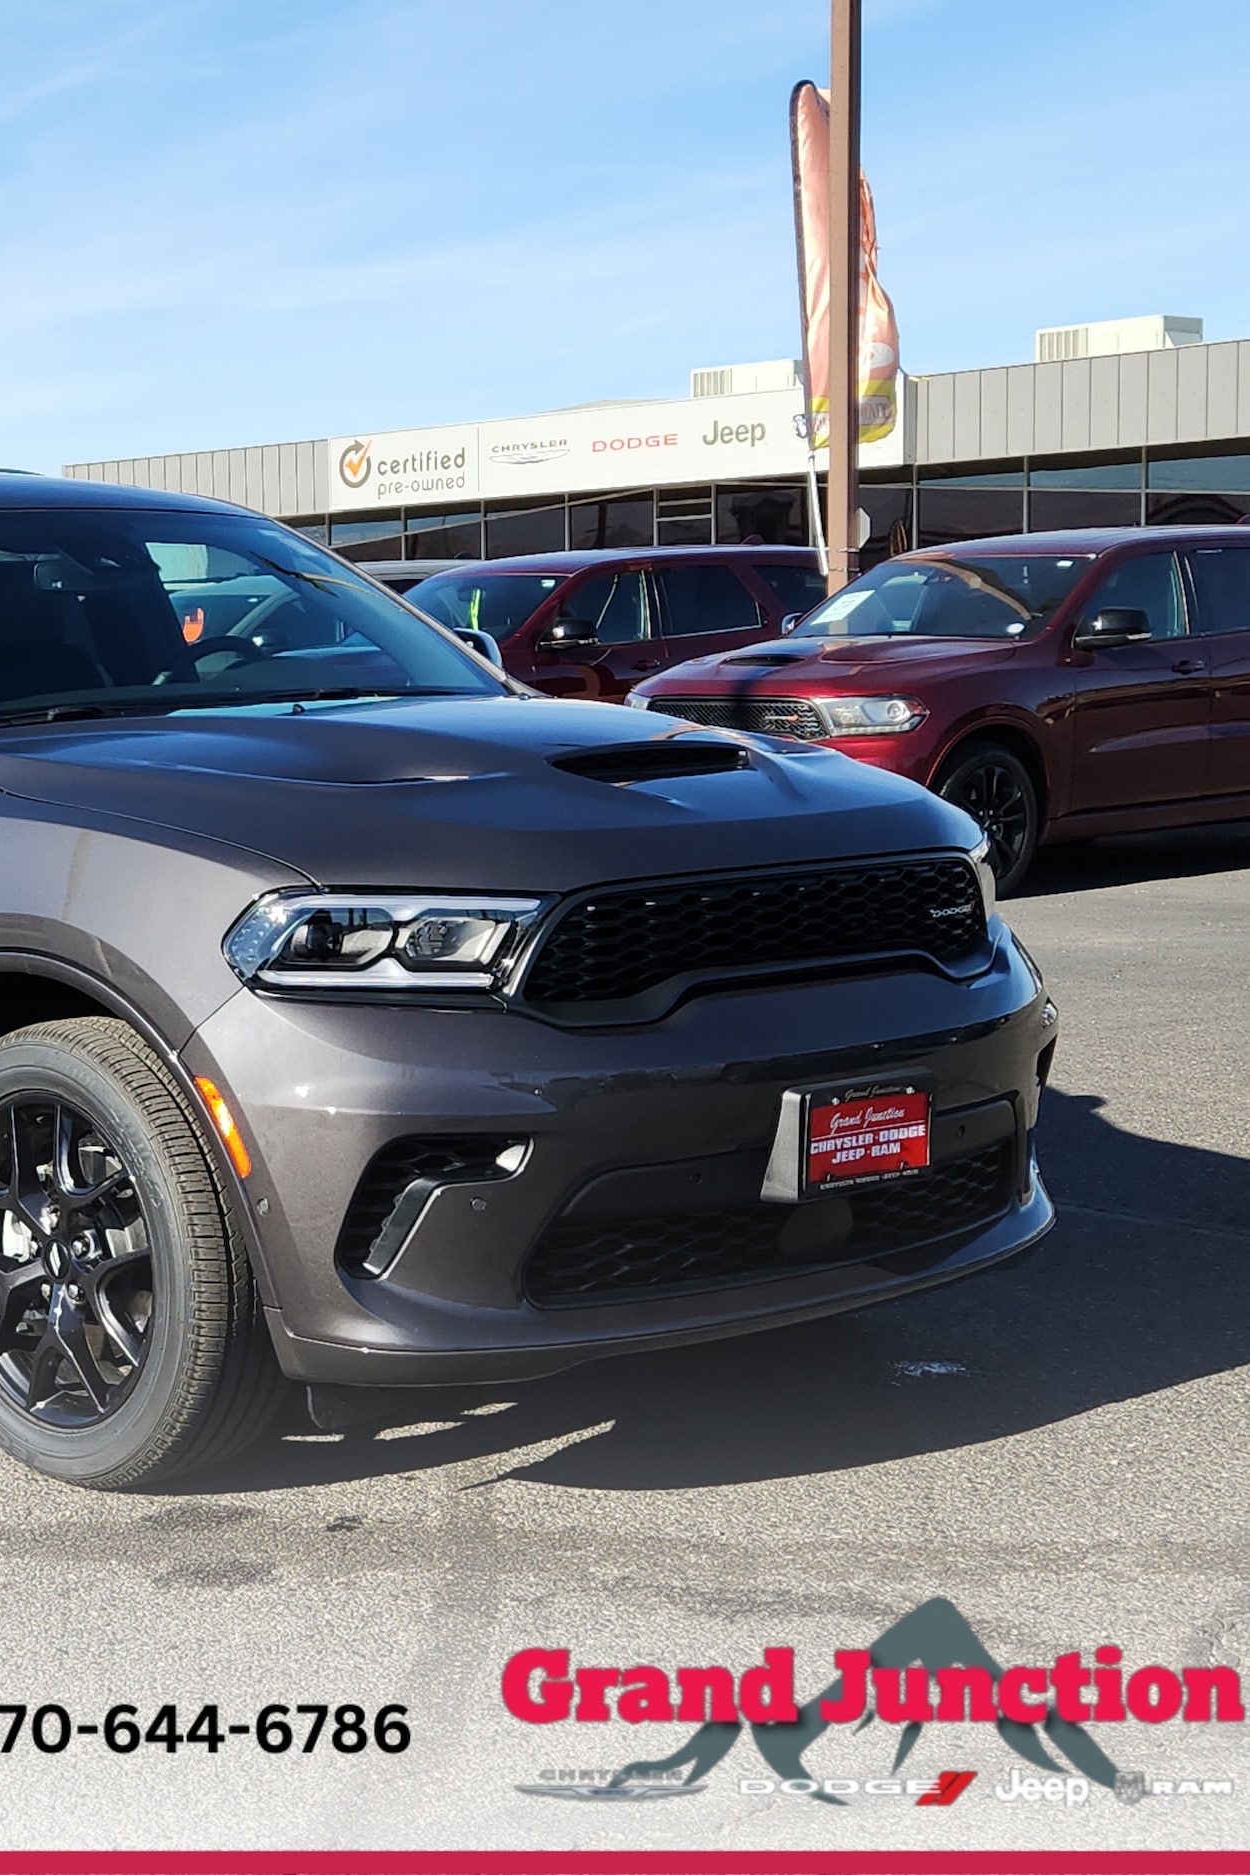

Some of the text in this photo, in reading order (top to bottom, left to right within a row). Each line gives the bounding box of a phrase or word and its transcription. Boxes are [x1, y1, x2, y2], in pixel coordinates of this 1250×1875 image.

[491, 438, 568, 453] CHRYSLER
[592, 433, 679, 453] DODGE
[702, 419, 767, 448] Jeep
[377, 446, 466, 476] certified
[377, 470, 466, 501] pre-owned
[829, 1106, 906, 1135] Grand Junction
[810, 1124, 926, 1155] CHRYSLER DODGE
[831, 1142, 901, 1165] JEEP RAM
